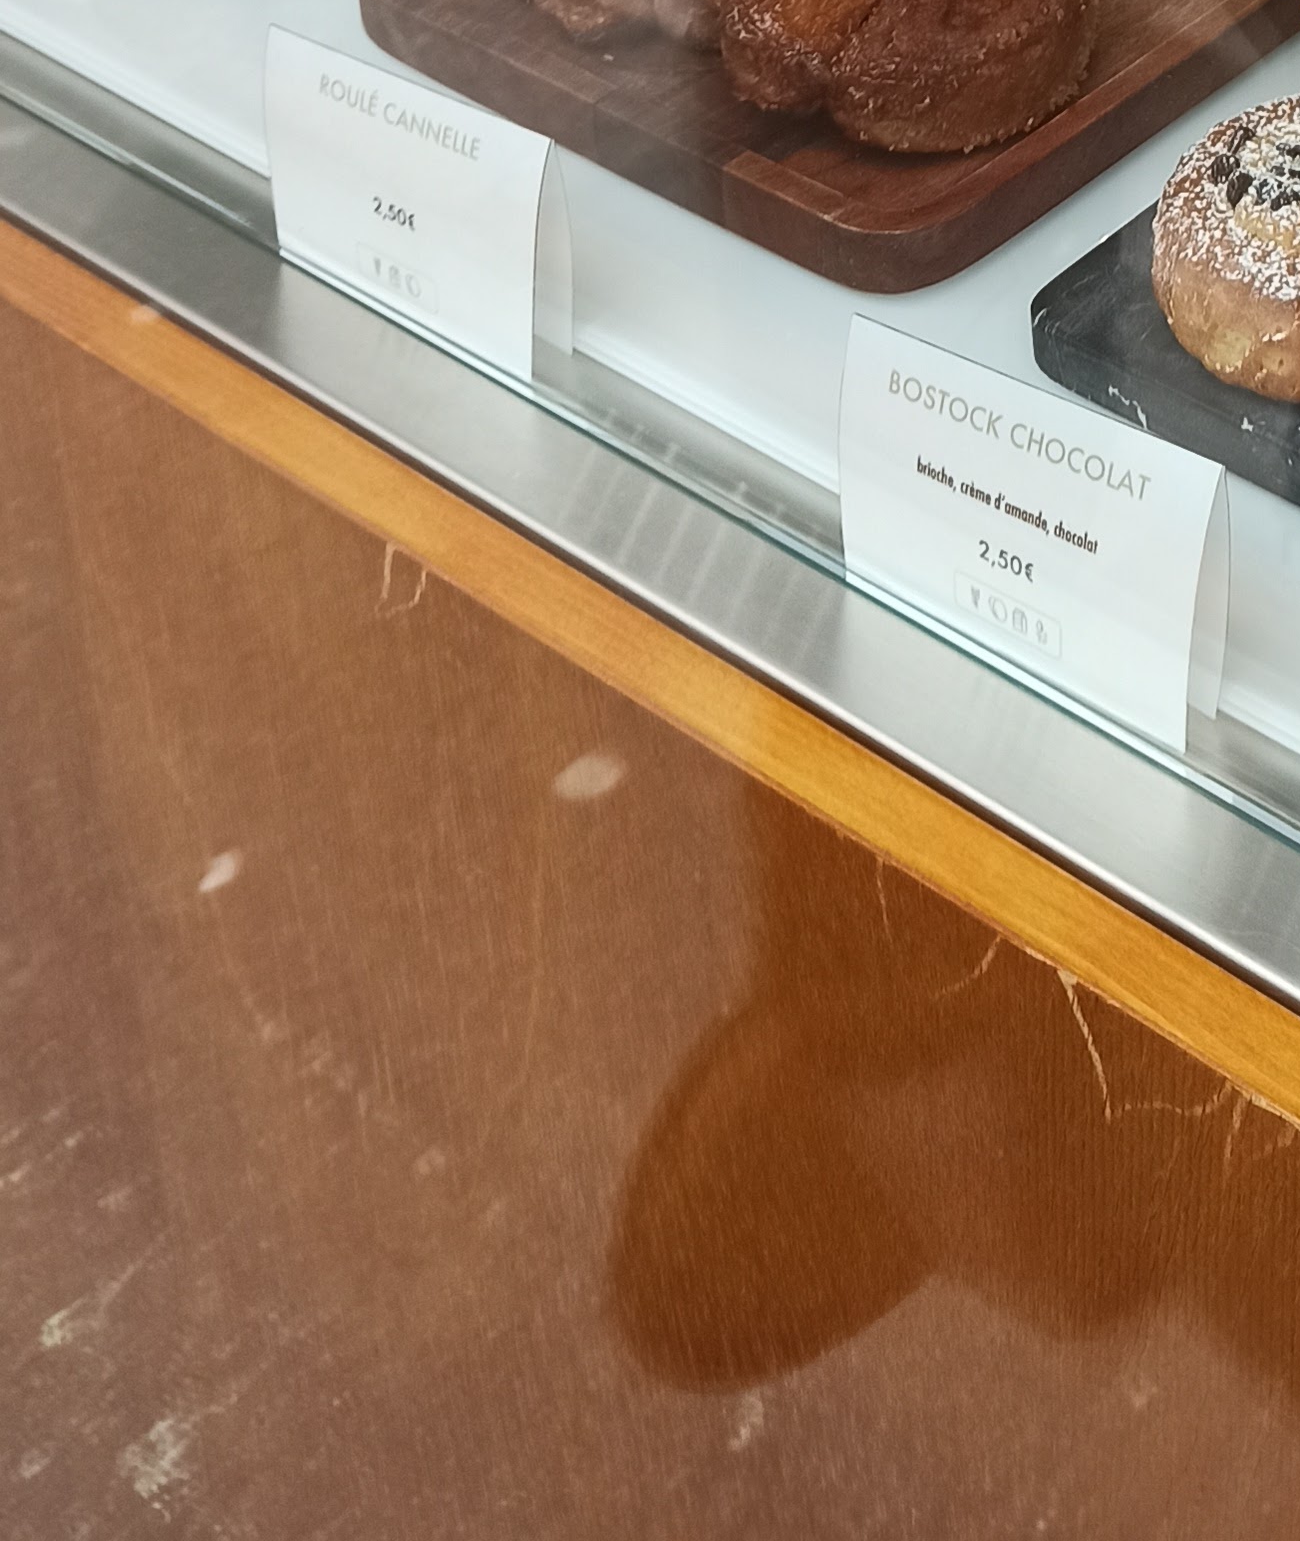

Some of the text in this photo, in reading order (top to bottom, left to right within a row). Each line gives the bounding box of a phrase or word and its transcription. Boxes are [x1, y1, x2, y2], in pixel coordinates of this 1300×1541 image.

[319, 72, 481, 162] ROULÉ CANNELLE
[372, 196, 417, 231] 2,50€
[888, 369, 1152, 501] BOSTOCK CHOCOLAT
[916, 454, 957, 492] brioche,
[960, 479, 992, 506] crème
[1053, 521, 1099, 555] chocolat
[978, 539, 1035, 583] 2,50€
